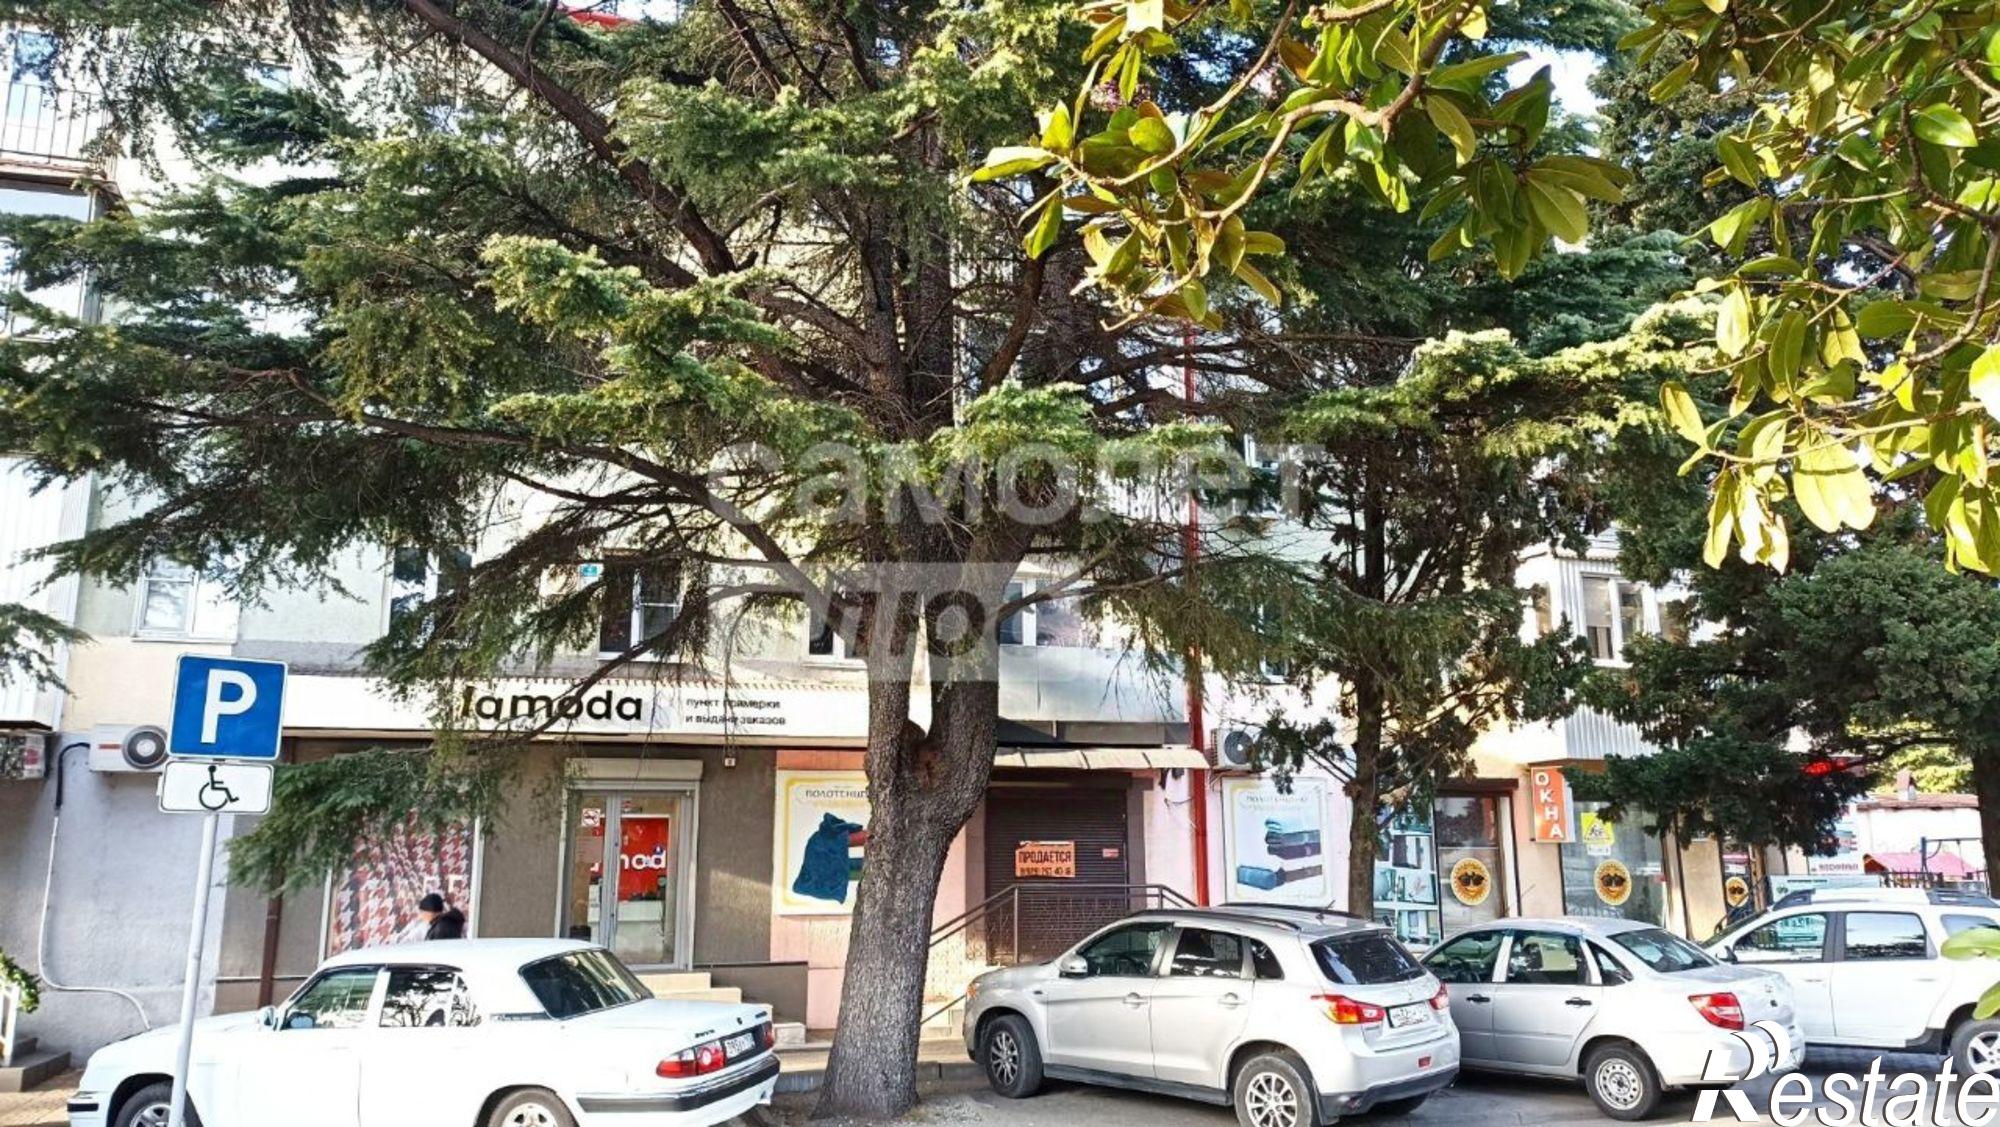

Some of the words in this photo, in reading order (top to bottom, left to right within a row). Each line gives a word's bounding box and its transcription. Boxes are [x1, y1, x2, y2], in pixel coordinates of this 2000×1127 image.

[201, 668, 257, 743] P
[462, 684, 642, 720] lamoda
[686, 698, 719, 709] пункт
[740, 717, 785, 725] заказов
[1535, 771, 1564, 839] ОКНА
[1017, 850, 1071, 864] ПРОДАЕТСЯ
